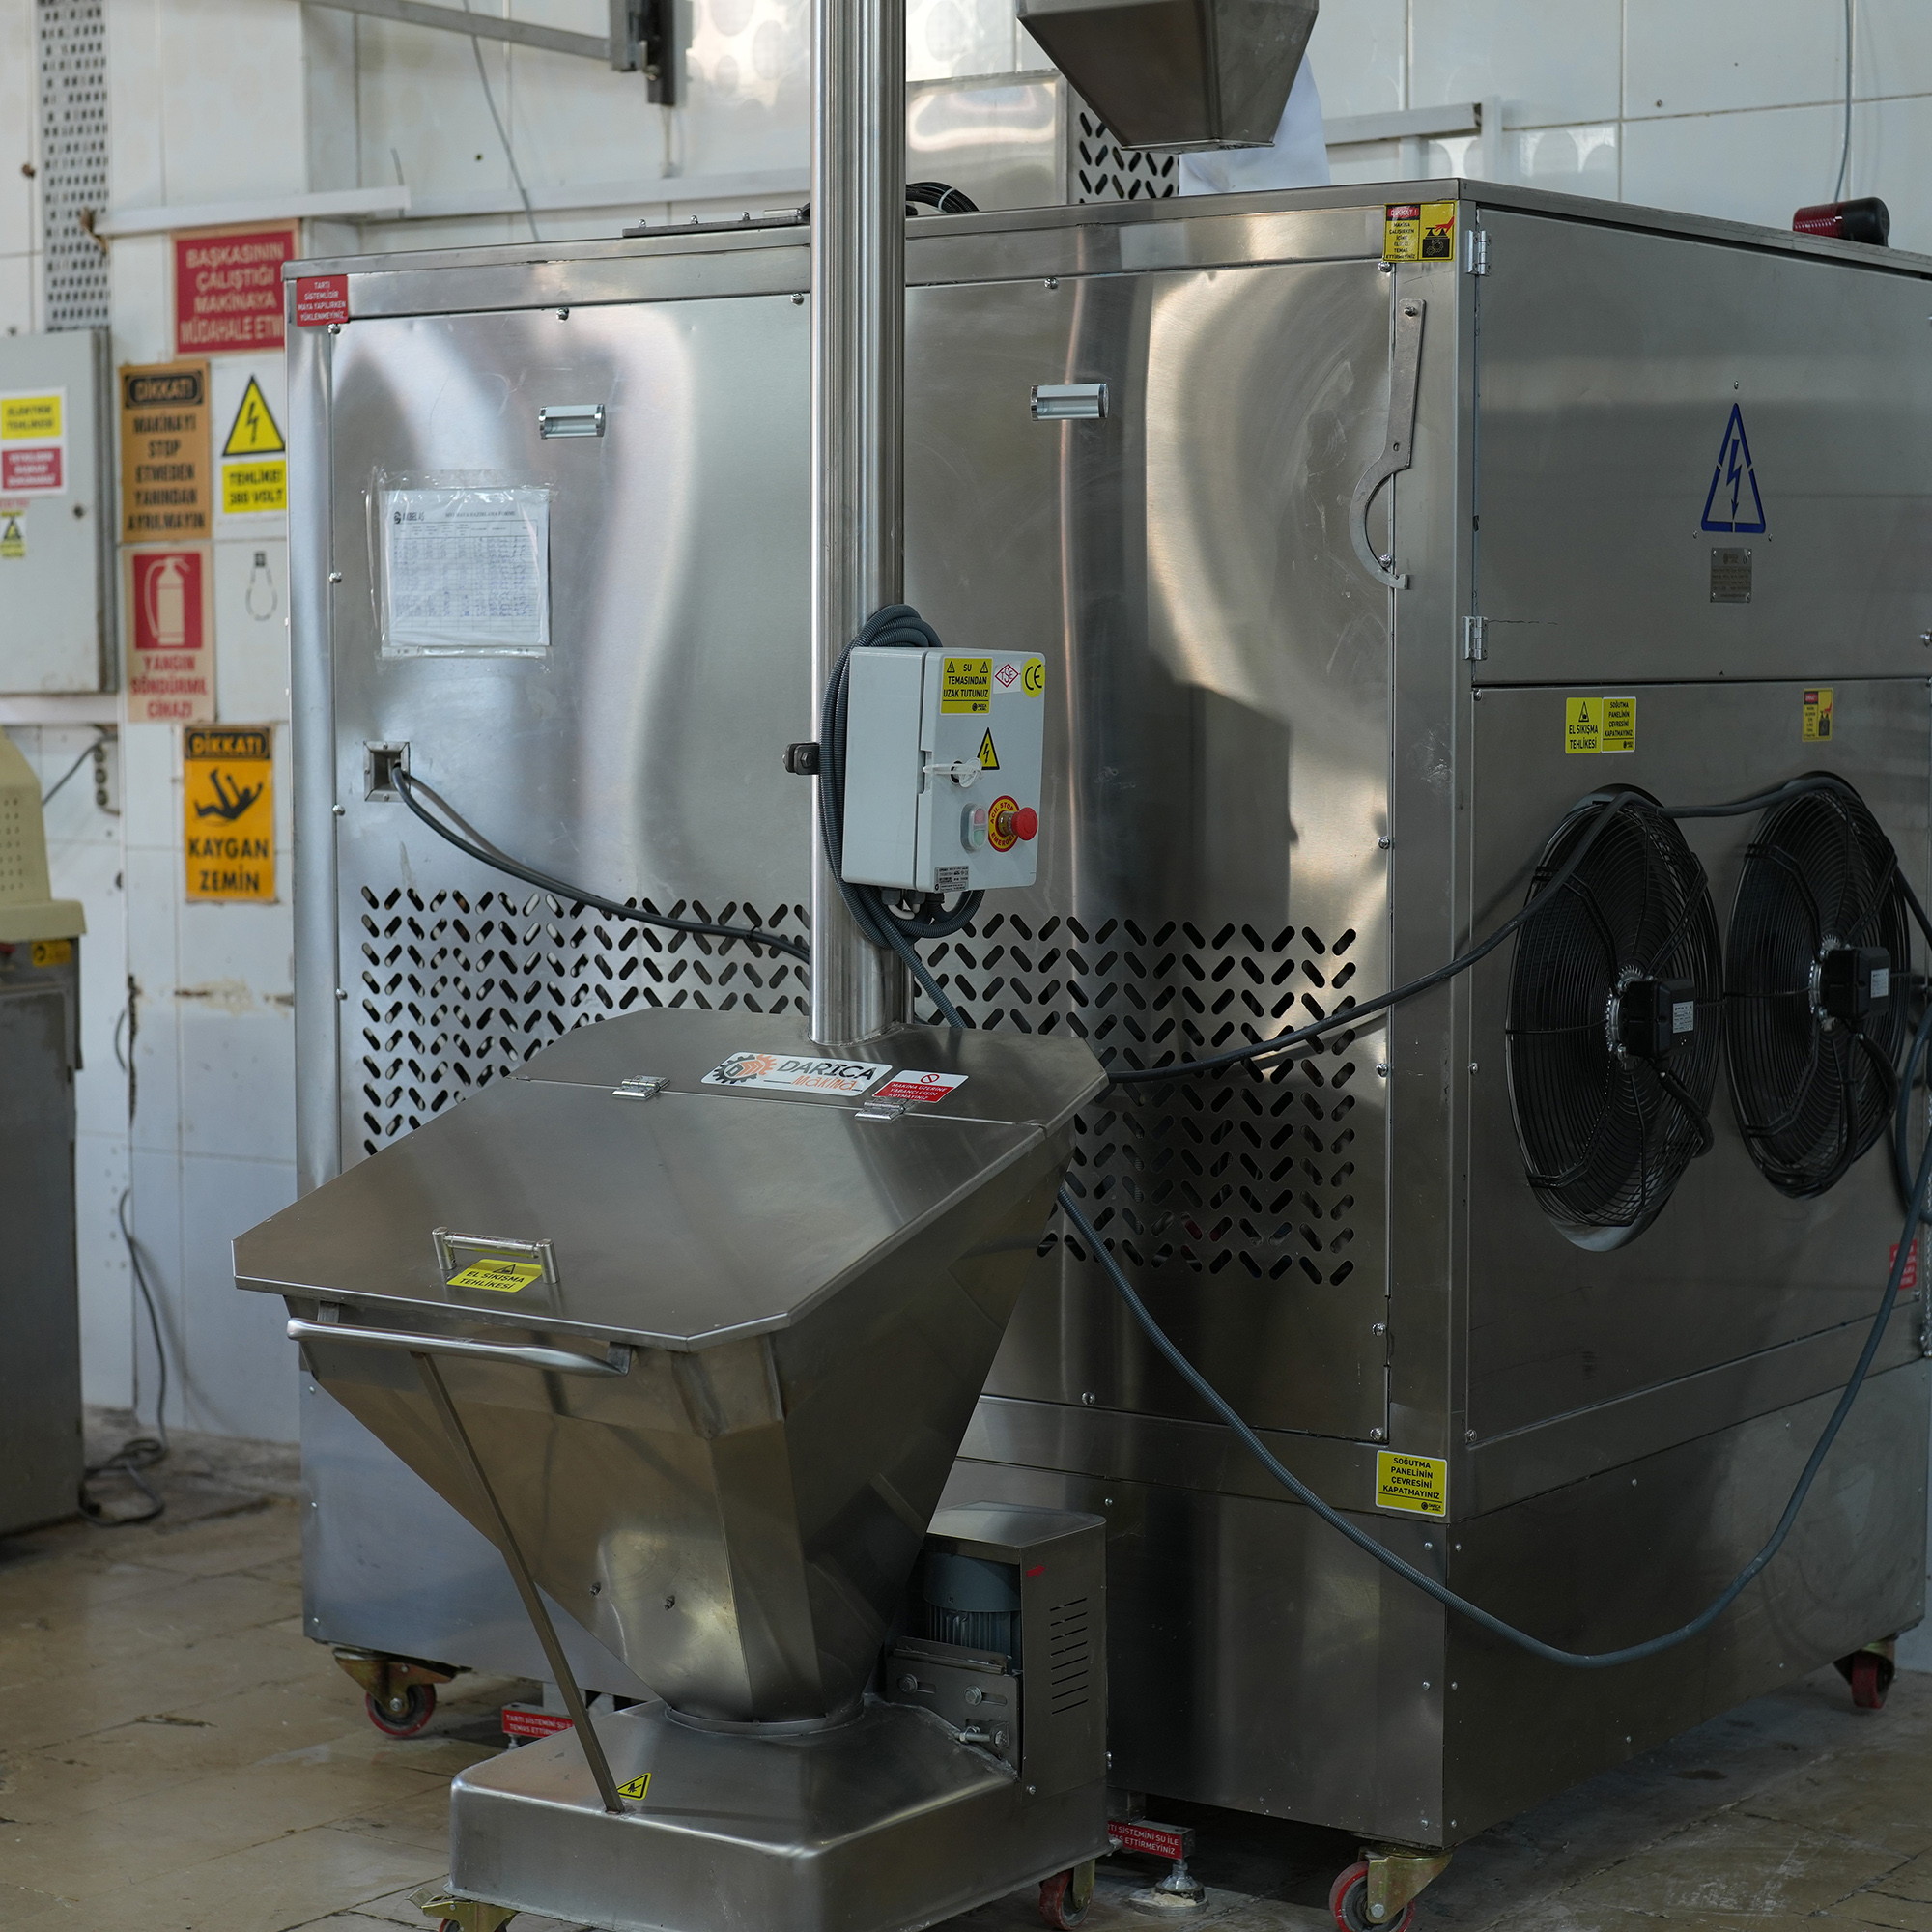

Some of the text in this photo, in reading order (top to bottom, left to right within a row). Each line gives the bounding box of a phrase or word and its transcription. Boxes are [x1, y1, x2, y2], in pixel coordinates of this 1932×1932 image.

[185, 242, 284, 269] BAŞKASININ
[149, 440, 181, 458] STOP
[253, 488, 283, 504] VOLT
[963, 664, 972, 672] SU
[948, 676, 987, 685] TEMASINDAN
[943, 689, 989, 697] UZAK TUTUNUZ
[1569, 724, 1599, 735] EL SIKIŞMA
[1570, 737, 1597, 749] TEHLİKESİ
[1000, 802, 1014, 810] STOP
[188, 838, 269, 859] KAYGAN
[200, 865, 260, 892] ZEMİN
[460, 1278, 516, 1290] TEHLİKESİ
[1393, 1457, 1432, 1469] SOĞUTMA
[1391, 1466, 1434, 1479] PANELİNİN
[1391, 1476, 1432, 1489] ÇEVRESİNİ
[1382, 1485, 1440, 1499] KAPATMAYINIZ
[1119, 1826, 1154, 1840] SİSTEMİNİ
[1167, 1834, 1179, 1846] İLE
[1125, 1837, 1176, 1855] ETTİRMEYİNİZ
